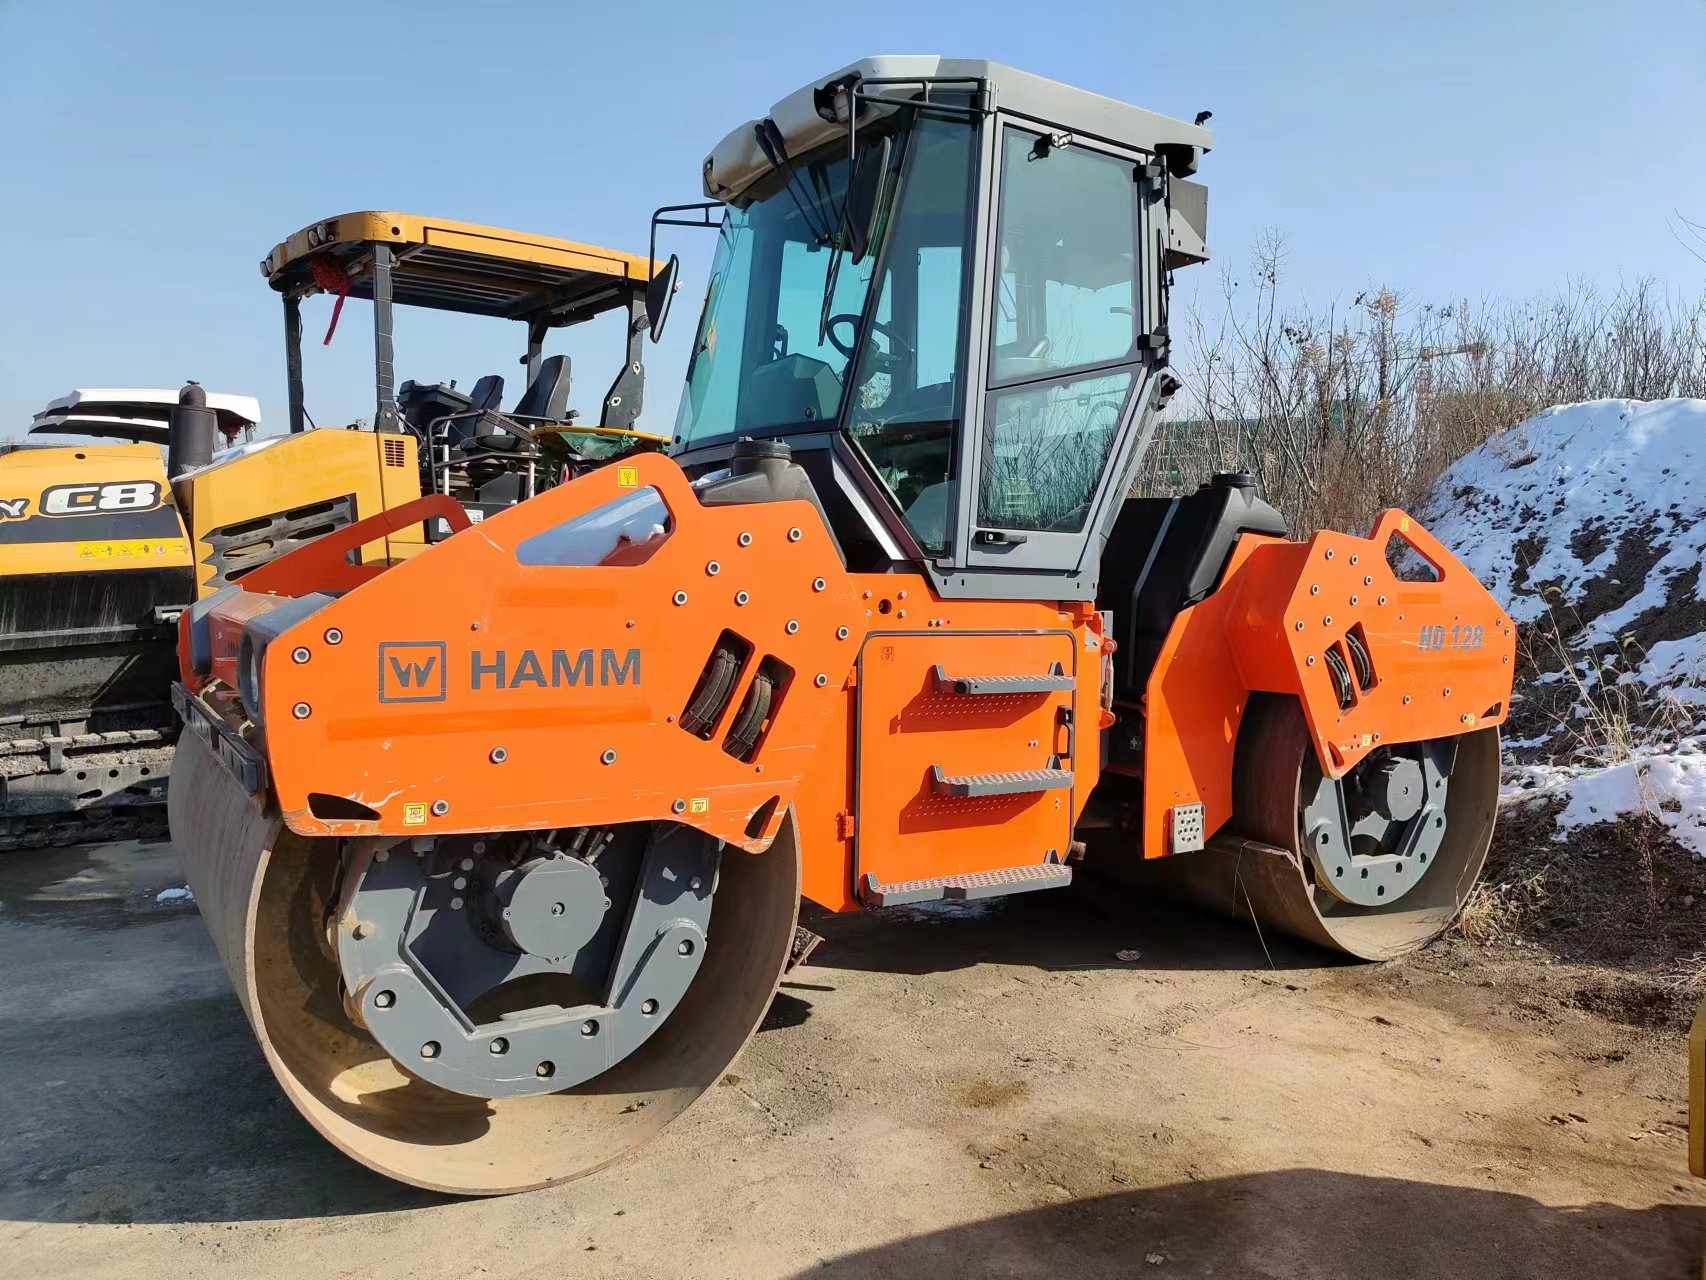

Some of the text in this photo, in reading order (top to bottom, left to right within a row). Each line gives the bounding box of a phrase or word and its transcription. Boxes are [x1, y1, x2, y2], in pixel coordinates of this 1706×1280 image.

[45, 482, 156, 514] C8
[1418, 625, 1483, 651] HD 128
[471, 648, 641, 690] HAMM
